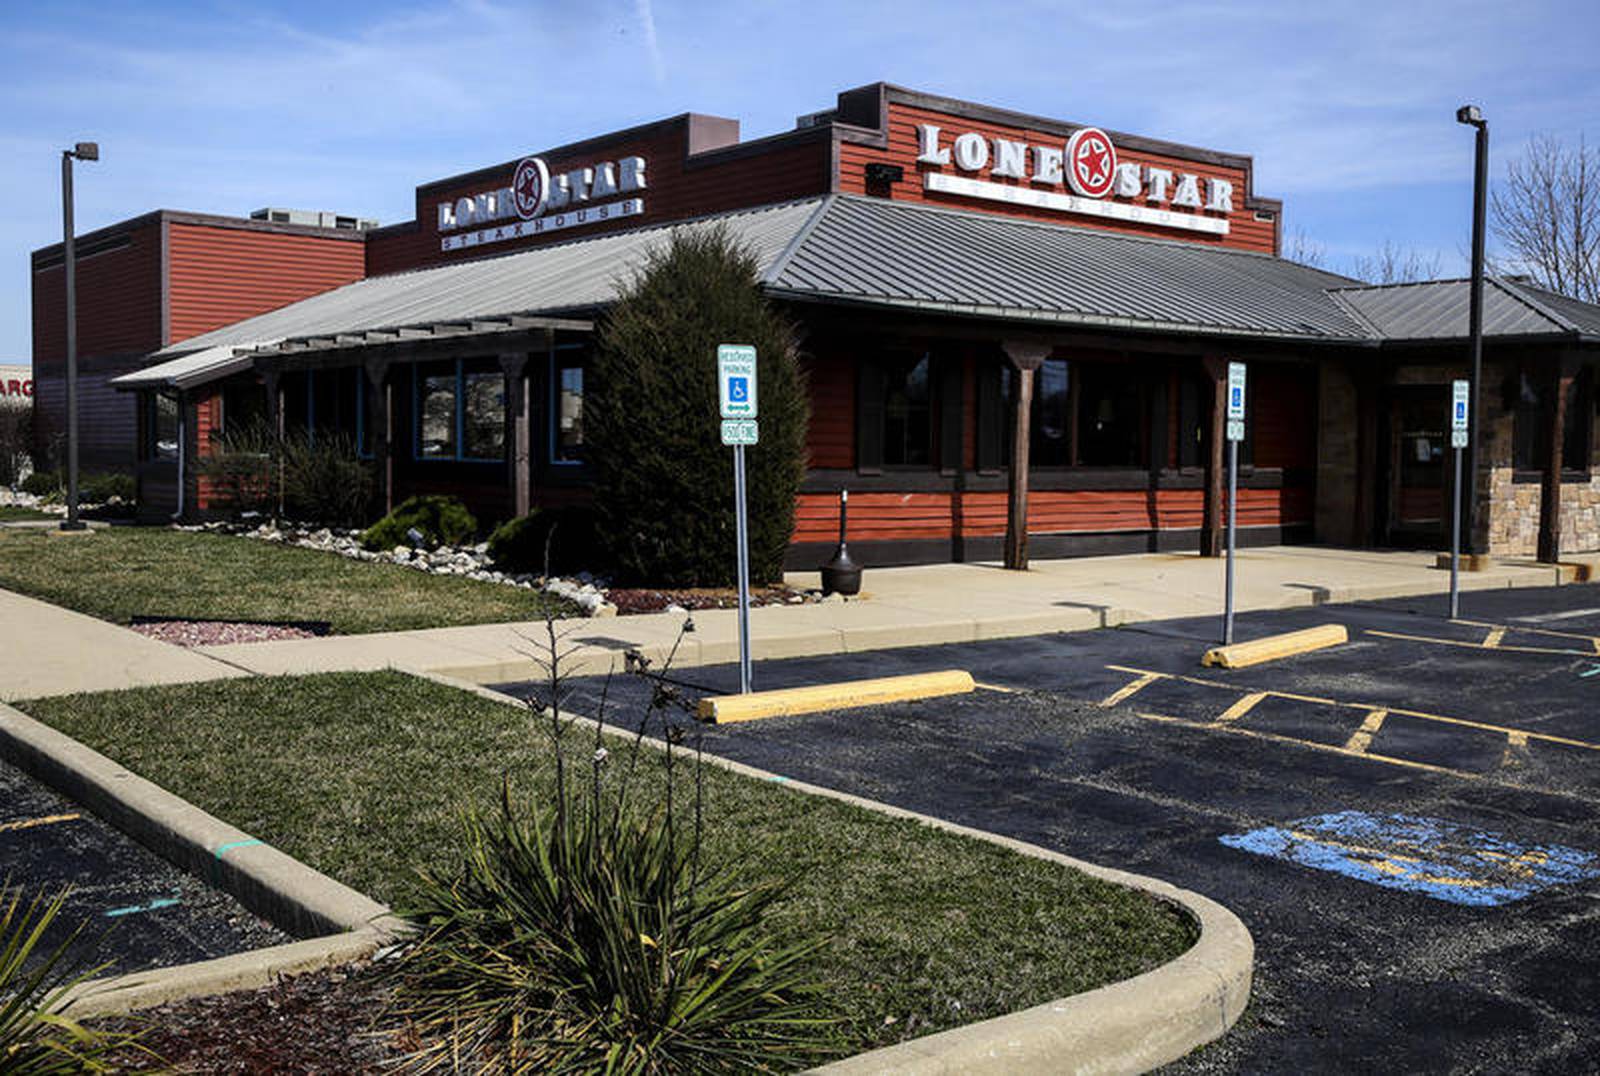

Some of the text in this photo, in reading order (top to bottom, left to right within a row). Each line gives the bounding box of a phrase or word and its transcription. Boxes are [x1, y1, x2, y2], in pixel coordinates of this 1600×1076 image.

[437, 156, 647, 231] LONE STAR
[917, 124, 1233, 212] LONE STAR
[442, 200, 633, 250] STEAKHOUSE
